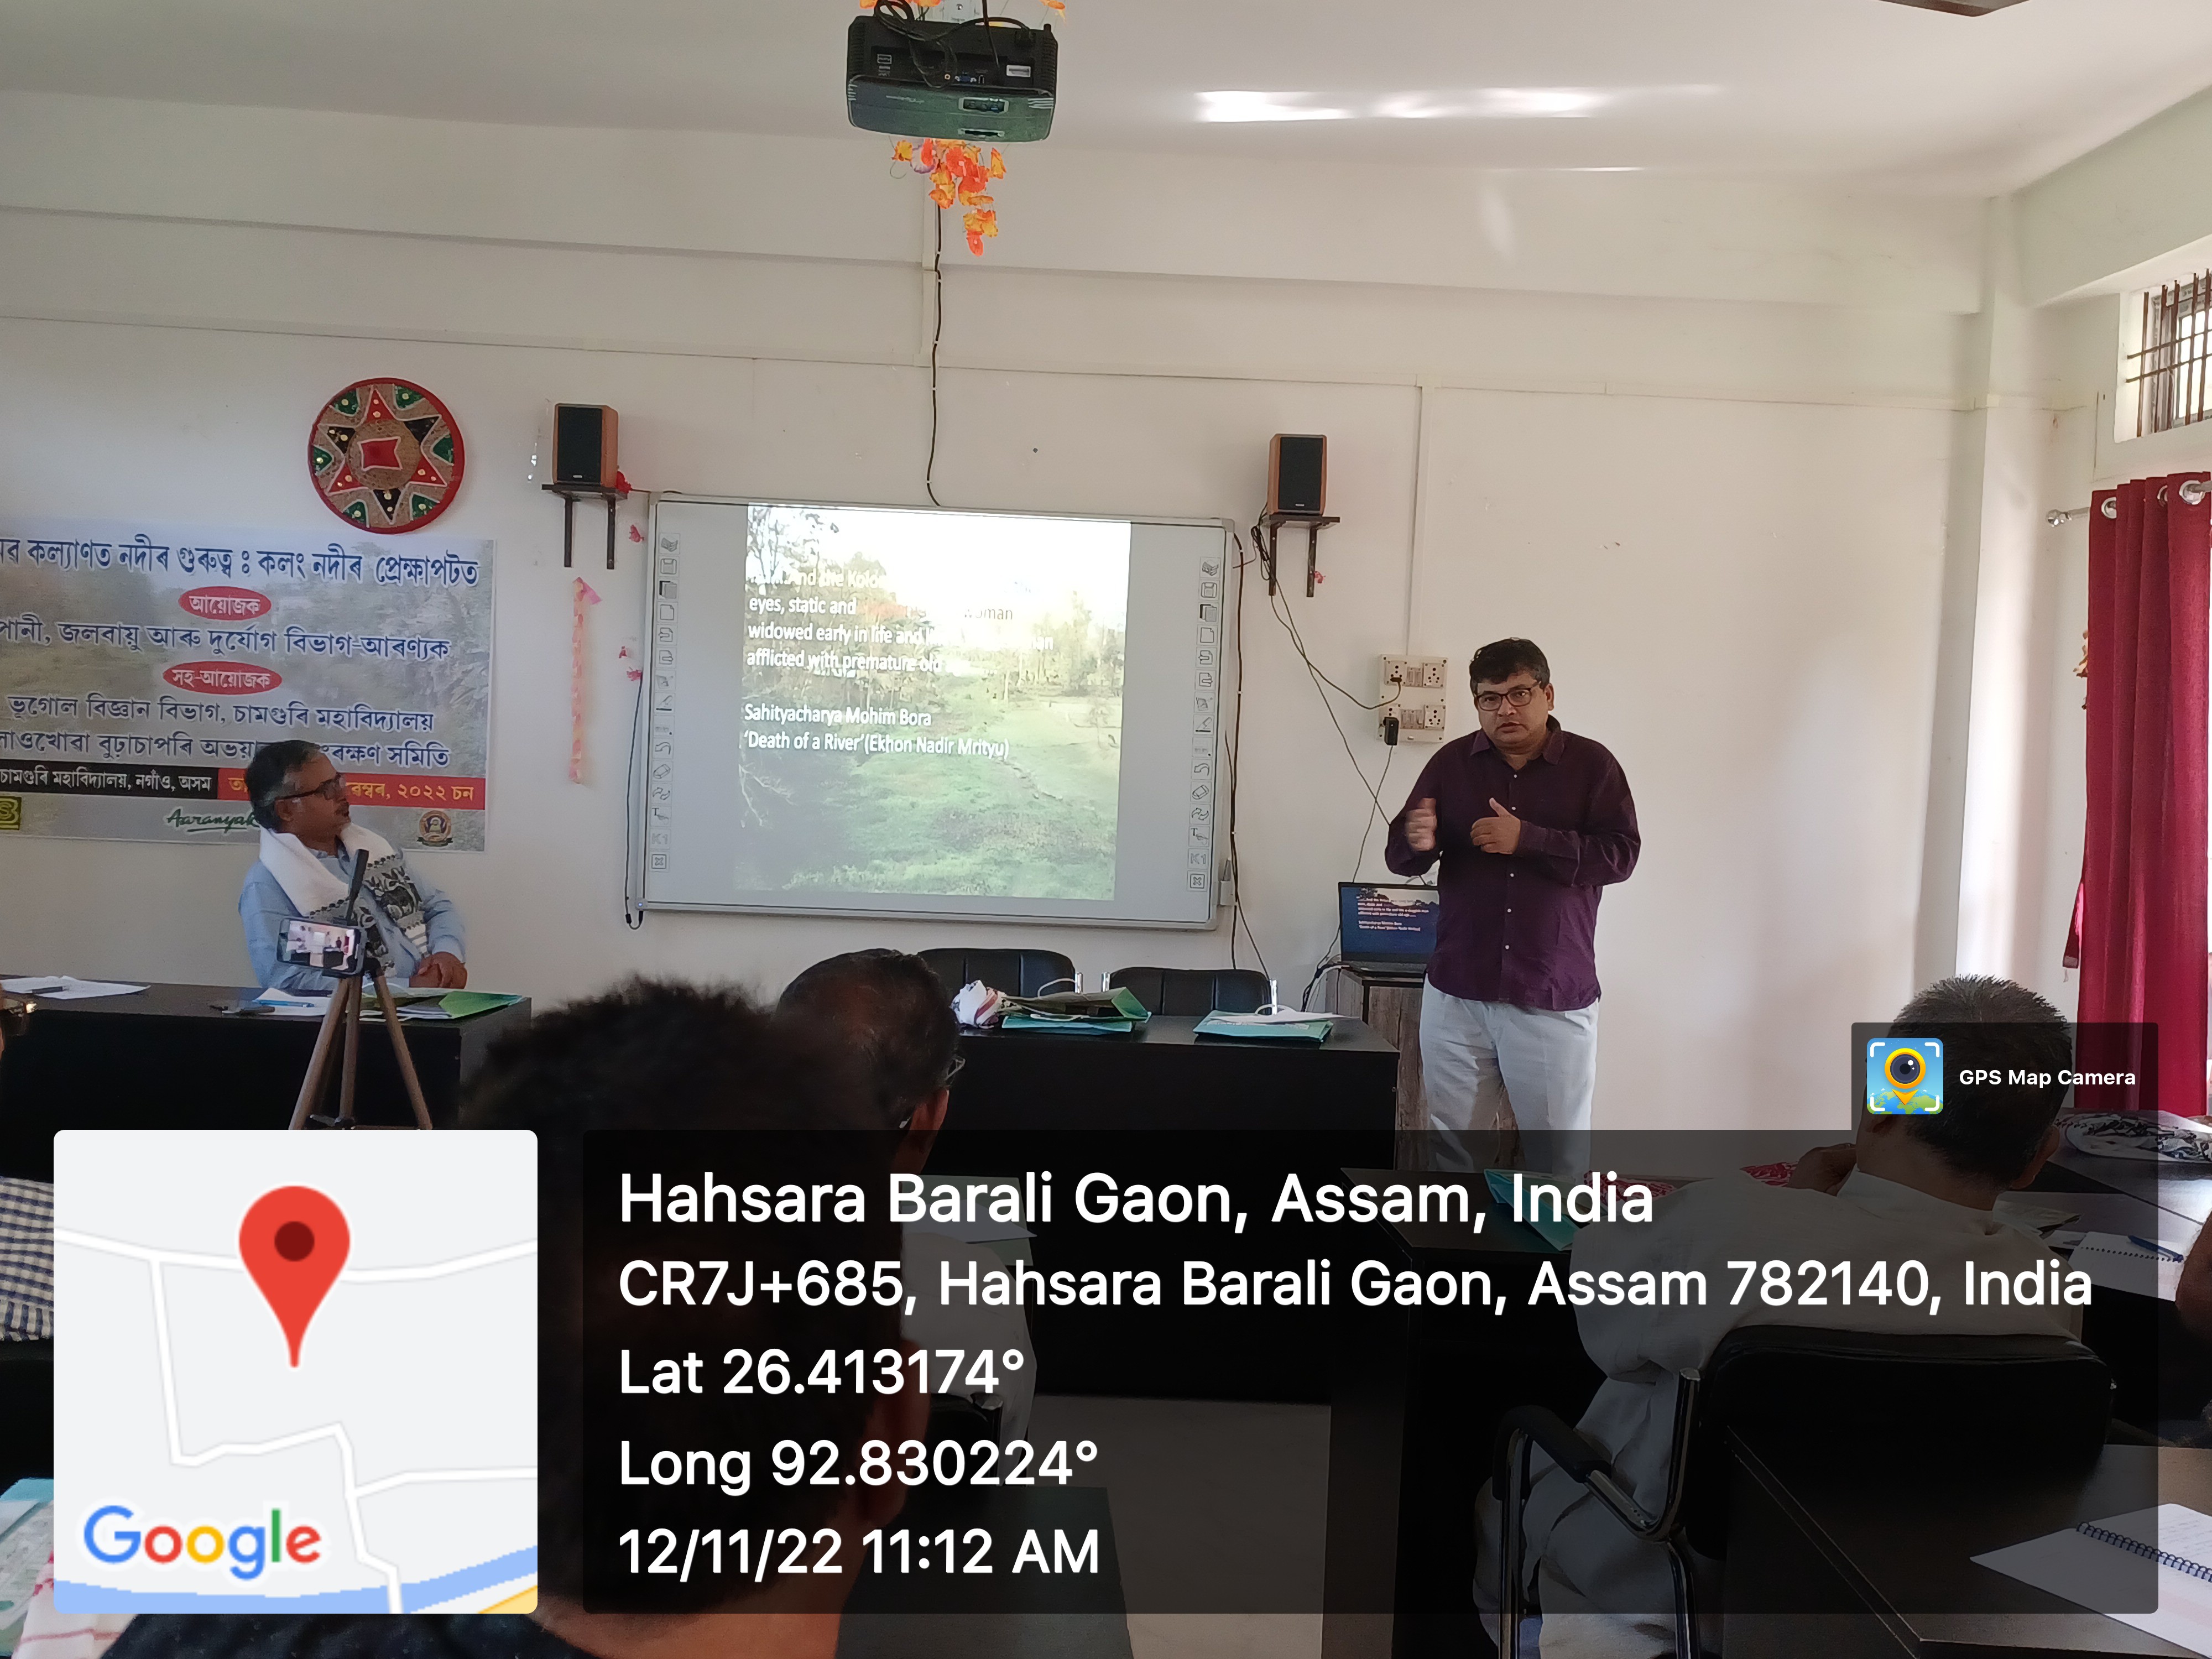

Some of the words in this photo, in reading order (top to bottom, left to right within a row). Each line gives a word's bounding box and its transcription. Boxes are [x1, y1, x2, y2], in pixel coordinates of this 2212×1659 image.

[27, 539, 112, 569] কল্যাণত
[118, 534, 170, 572] নদীৰ
[178, 546, 233, 578] গুৰুত্ব
[256, 550, 305, 578] কলং
[312, 543, 363, 581] নদীৰ
[376, 550, 479, 586] প্ৰেক্ষাপটত
[189, 594, 260, 615] আয়োজক
[749, 597, 785, 615] eyes,
[789, 596, 826, 614] static
[830, 597, 857, 614] and
[58, 623, 142, 651] জলবায়ু
[146, 627, 201, 648] আৰু
[748, 622, 812, 640] widowed
[816, 624, 852, 645] early
[854, 625, 868, 643] in
[871, 625, 893, 644] life
[896, 627, 922, 645] and
[747, 649, 805, 668] afflicted
[807, 651, 842, 669] with
[172, 669, 270, 688] সহ-আয়োজক
[8, 696, 78, 718] ভূগোল
[86, 693, 150, 719] বিজ্ঞান
[158, 696, 226, 724] বিভাগ,
[315, 703, 434, 731] মহাবিদ্যালয়
[744, 703, 842, 726] Sahityacharya
[846, 706, 896, 725] Mohim
[899, 708, 932, 726] Bora
[387, 740, 449, 766] সমিতি
[794, 732, 808, 750] of
[812, 736, 820, 750] a
[916, 736, 955, 754] Nadir
[957, 738, 1009, 760] Mrityu)
[52, 767, 132, 791] মহাবিদ্যালয়,
[179, 775, 212, 791] অসম
[398, 784, 446, 801] ২০২২
[451, 786, 474, 801] চন
